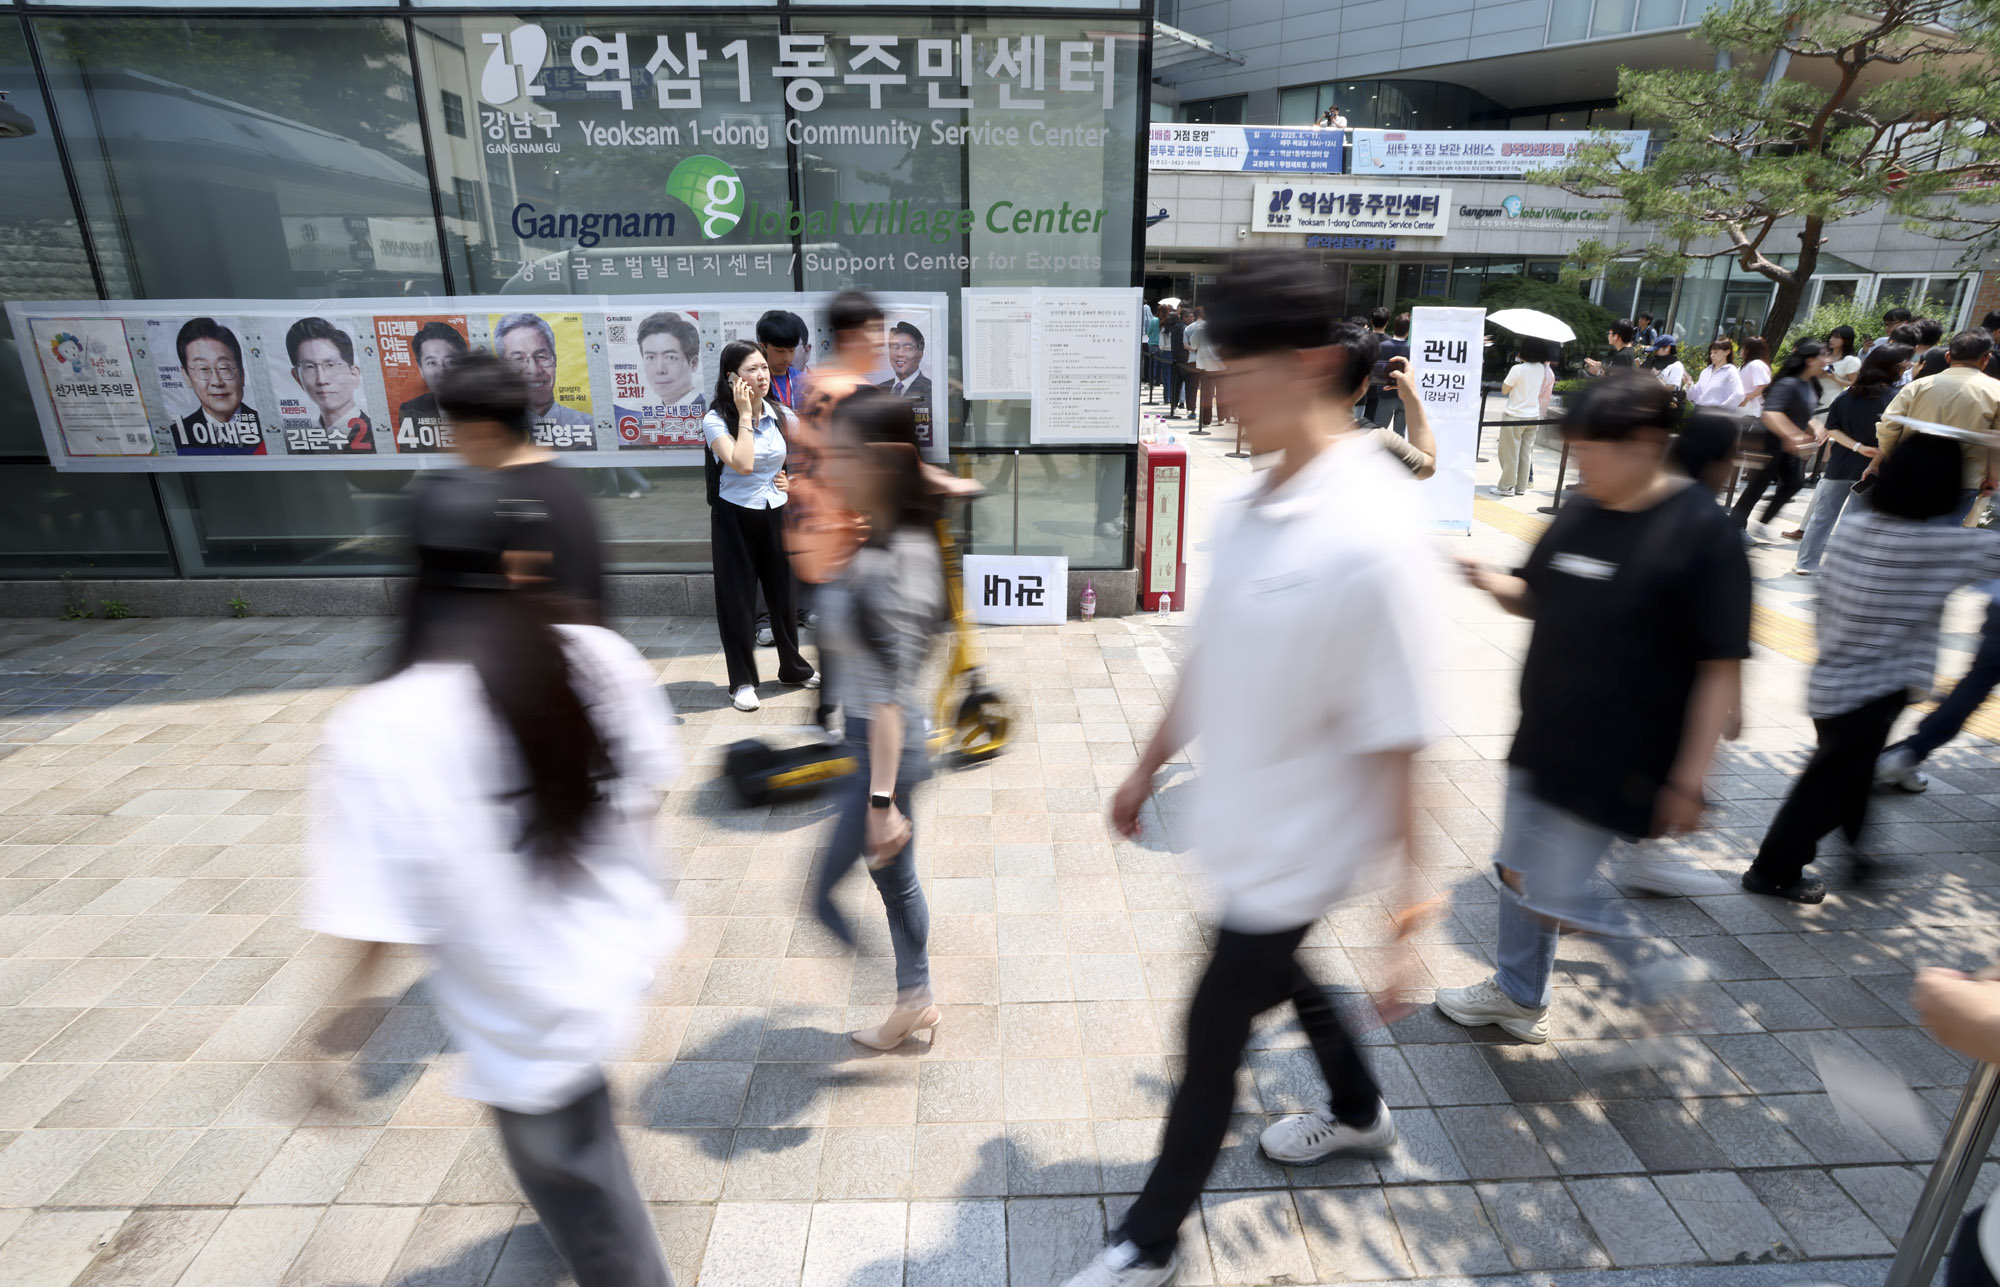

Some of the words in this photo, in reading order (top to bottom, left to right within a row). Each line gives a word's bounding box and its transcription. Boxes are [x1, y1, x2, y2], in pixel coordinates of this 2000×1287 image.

[570, 32, 1115, 111] 역삼1동주민센터
[481, 111, 561, 139] 강남구
[579, 120, 679, 146] Yeoksam
[689, 120, 769, 149] 1-dong
[786, 119, 921, 149] Community
[931, 119, 1019, 146] Service
[1028, 120, 1110, 147] Center
[1174, 130, 1190, 141] 거점
[1205, 146, 1238, 158] 드립니다
[1462, 143, 1495, 156] 서비스
[1298, 191, 1440, 217] 역삼1동주민센터
[1459, 205, 1502, 219] Gangnam
[1546, 208, 1577, 222] Village
[511, 202, 676, 249] Gangnam
[849, 199, 976, 245] Village
[985, 200, 1109, 234] Center
[1297, 217, 1325, 227] Yeoksam
[1327, 218, 1350, 228] 1-dong
[1351, 219, 1387, 229] Community
[1389, 220, 1412, 229] Service
[1413, 220, 1435, 230] Center
[517, 254, 772, 282] 강남글로벌빌리지센터
[806, 253, 895, 275] Support
[904, 252, 979, 270] Center
[988, 252, 1016, 270] for
[1027, 252, 1101, 273] Expats
[378, 320, 418, 336] 미래를
[380, 337, 408, 351] 여는
[1423, 339, 1468, 364] 관내
[383, 351, 411, 367] 선택
[615, 372, 639, 385] 정치
[1421, 373, 1466, 390] 선거인
[55, 383, 99, 397] 선거벽보
[101, 383, 134, 397] 주의문
[617, 386, 645, 399] 교체!
[193, 422, 261, 445] 이재명
[286, 428, 349, 451] 김문수
[347, 417, 371, 450] 2
[396, 417, 419, 449] 4
[532, 424, 592, 447] 권영국
[619, 415, 641, 442] 6
